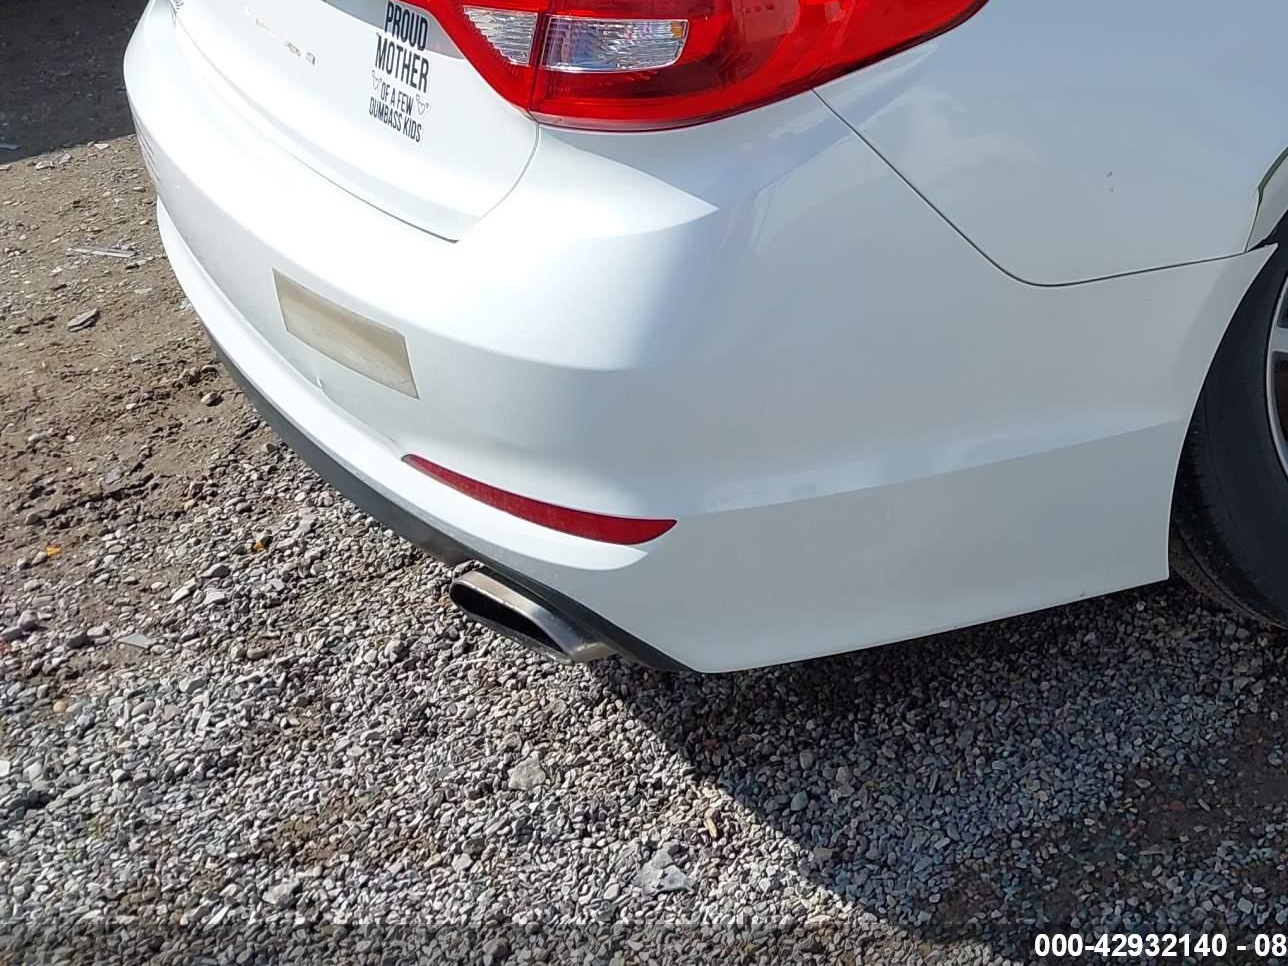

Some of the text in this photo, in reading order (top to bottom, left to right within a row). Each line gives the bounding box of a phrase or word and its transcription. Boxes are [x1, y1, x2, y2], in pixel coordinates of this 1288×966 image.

[384, 0, 429, 52] PROUD
[374, 33, 430, 94] MOTHER
[368, 96, 422, 143] DUMBASS KIDS
[380, 81, 415, 117] OF A FEW
